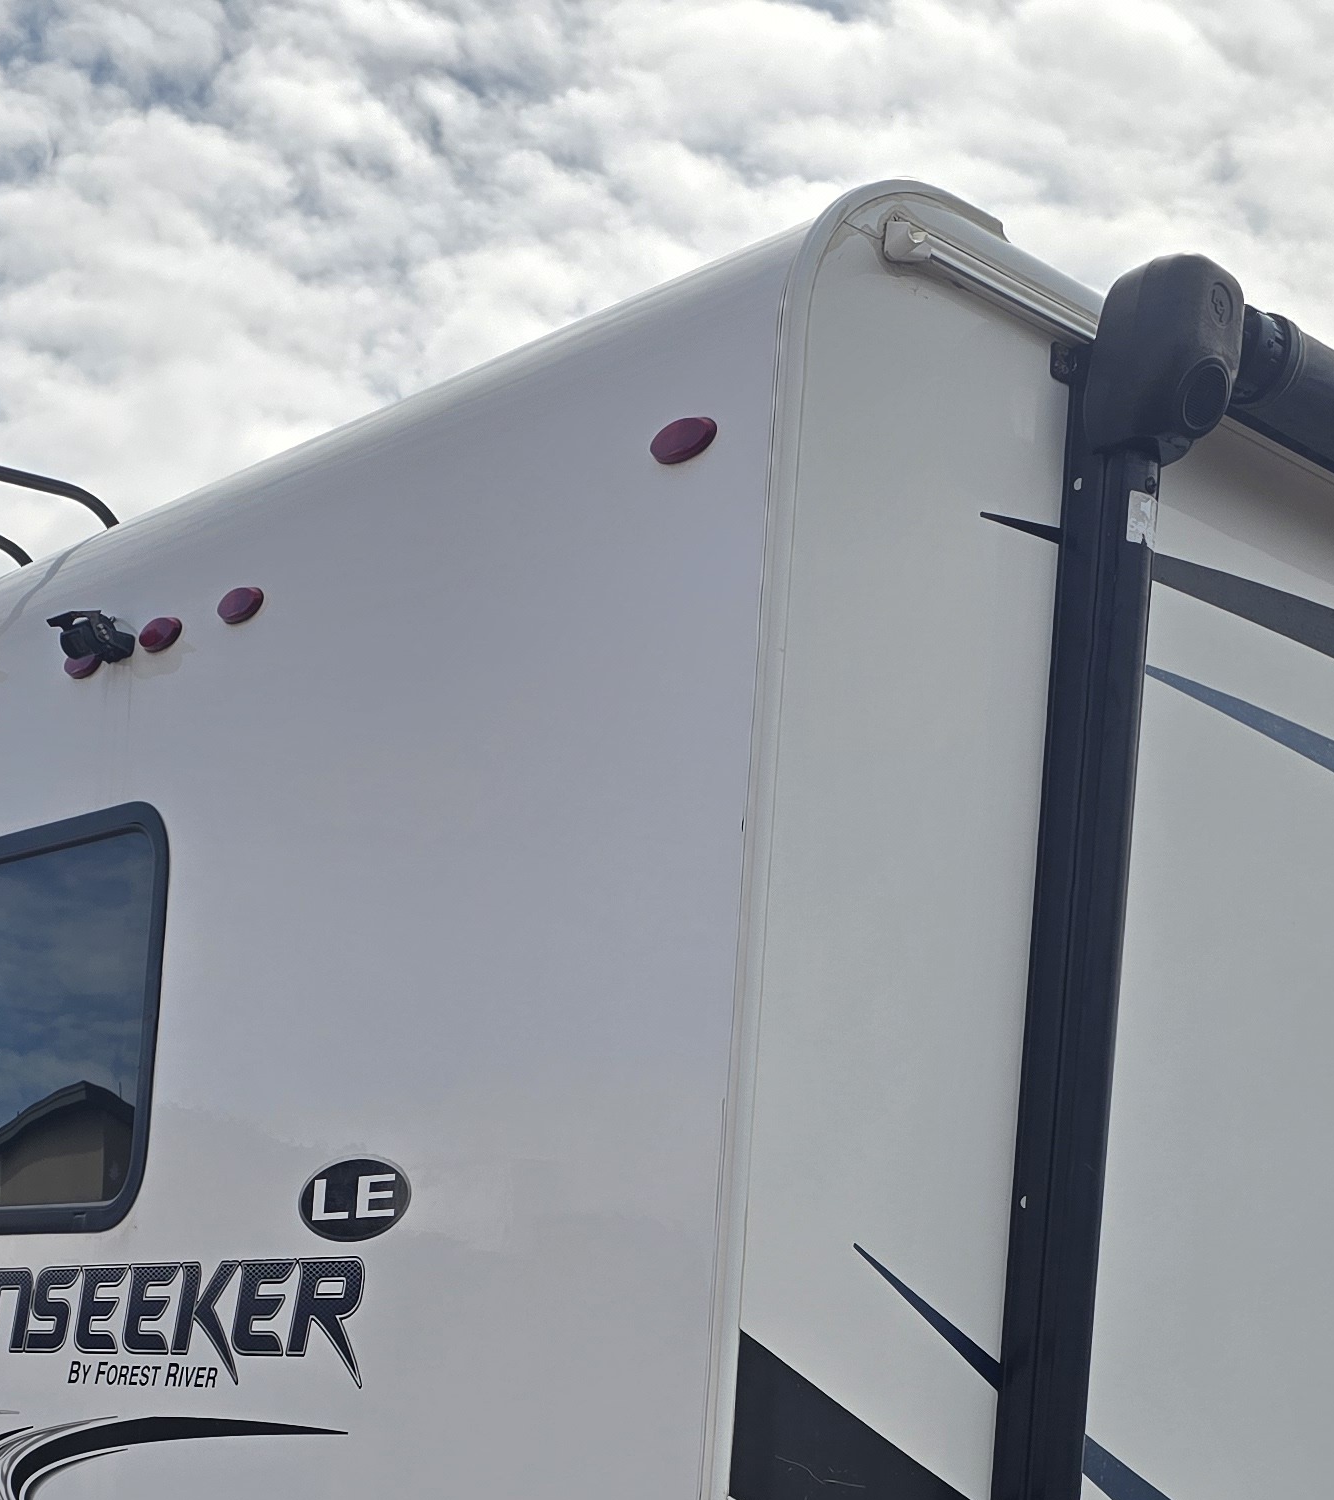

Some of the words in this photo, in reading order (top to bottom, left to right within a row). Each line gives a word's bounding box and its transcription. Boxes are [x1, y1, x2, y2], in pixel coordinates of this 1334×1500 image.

[311, 1173, 396, 1222] LE
[94, 1362, 161, 1388] FOREST
[165, 1363, 218, 1389] RIVER
